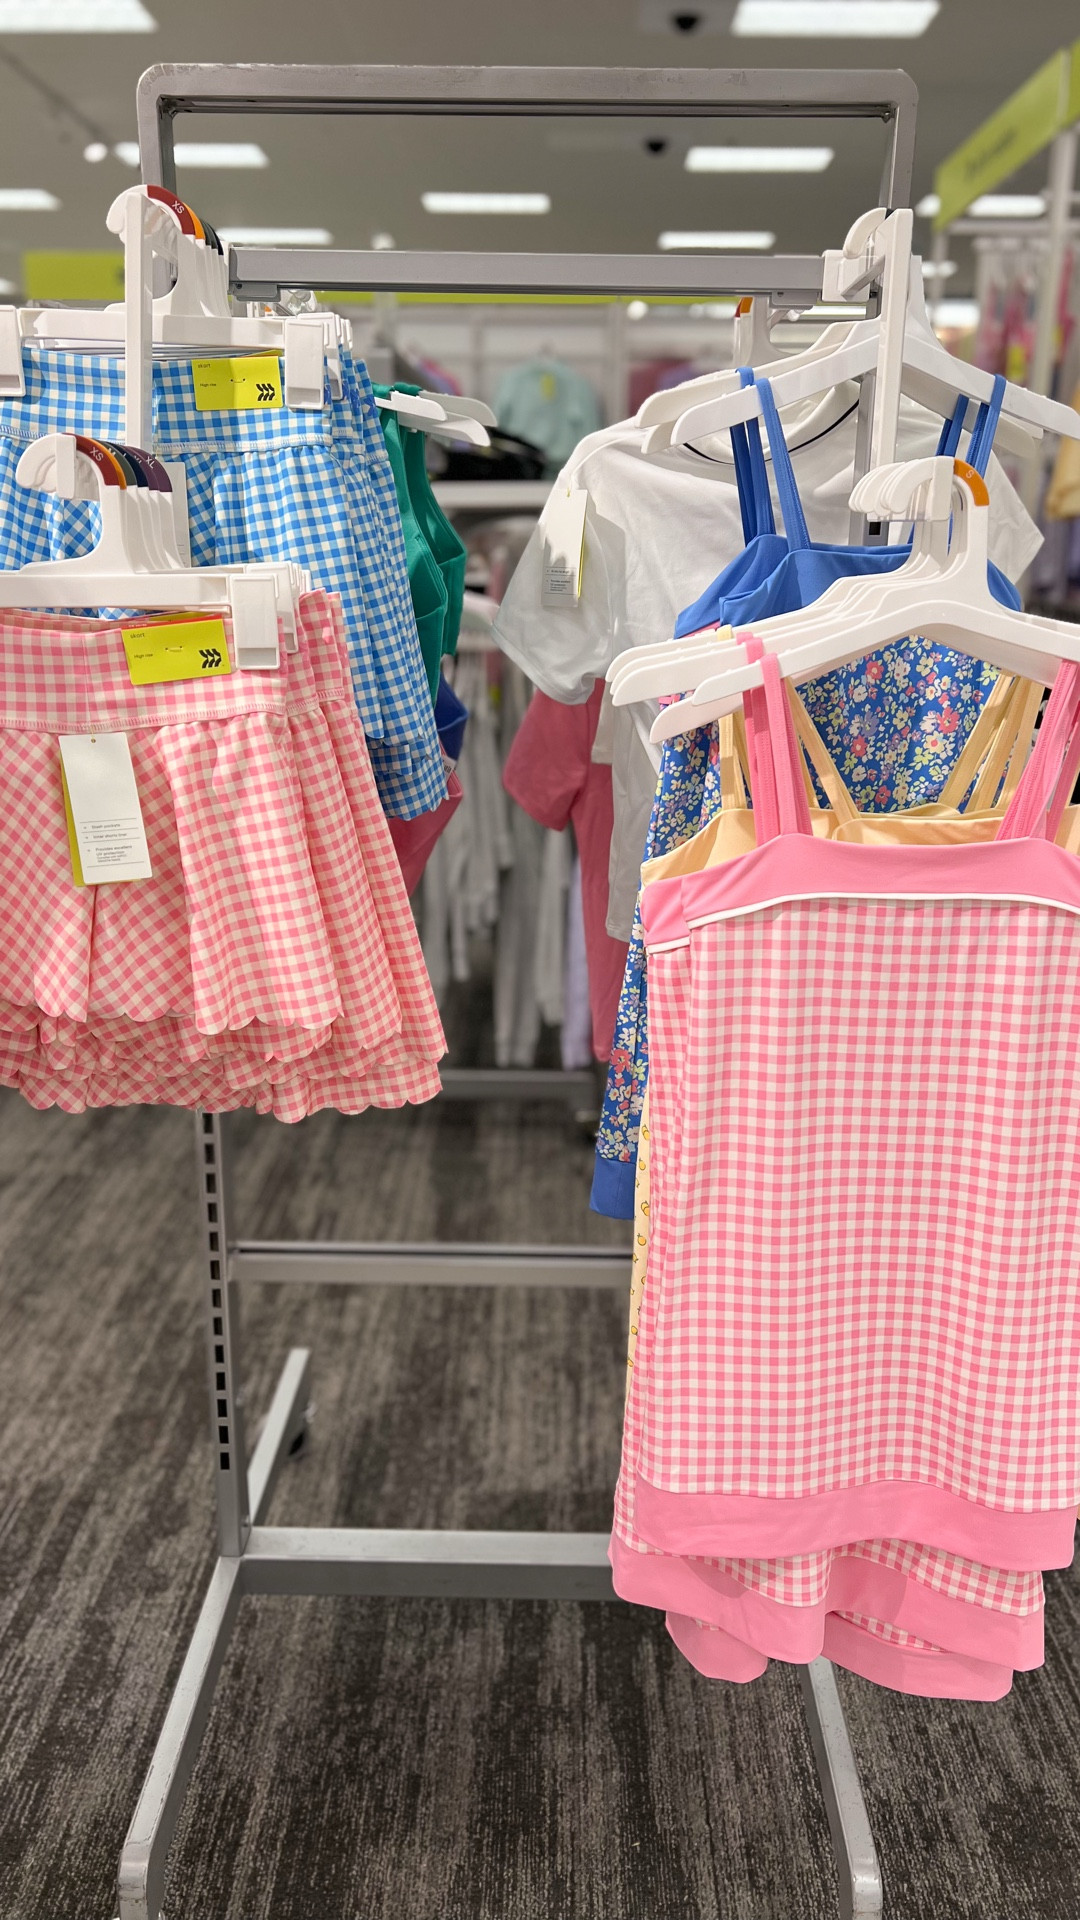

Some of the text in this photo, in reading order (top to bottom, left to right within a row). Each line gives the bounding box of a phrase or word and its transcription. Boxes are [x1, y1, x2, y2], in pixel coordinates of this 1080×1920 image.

[172, 200, 185, 214] XS
[89, 446, 104, 462] XS
[145, 455, 155, 469] XL
[965, 469, 975, 479] S
